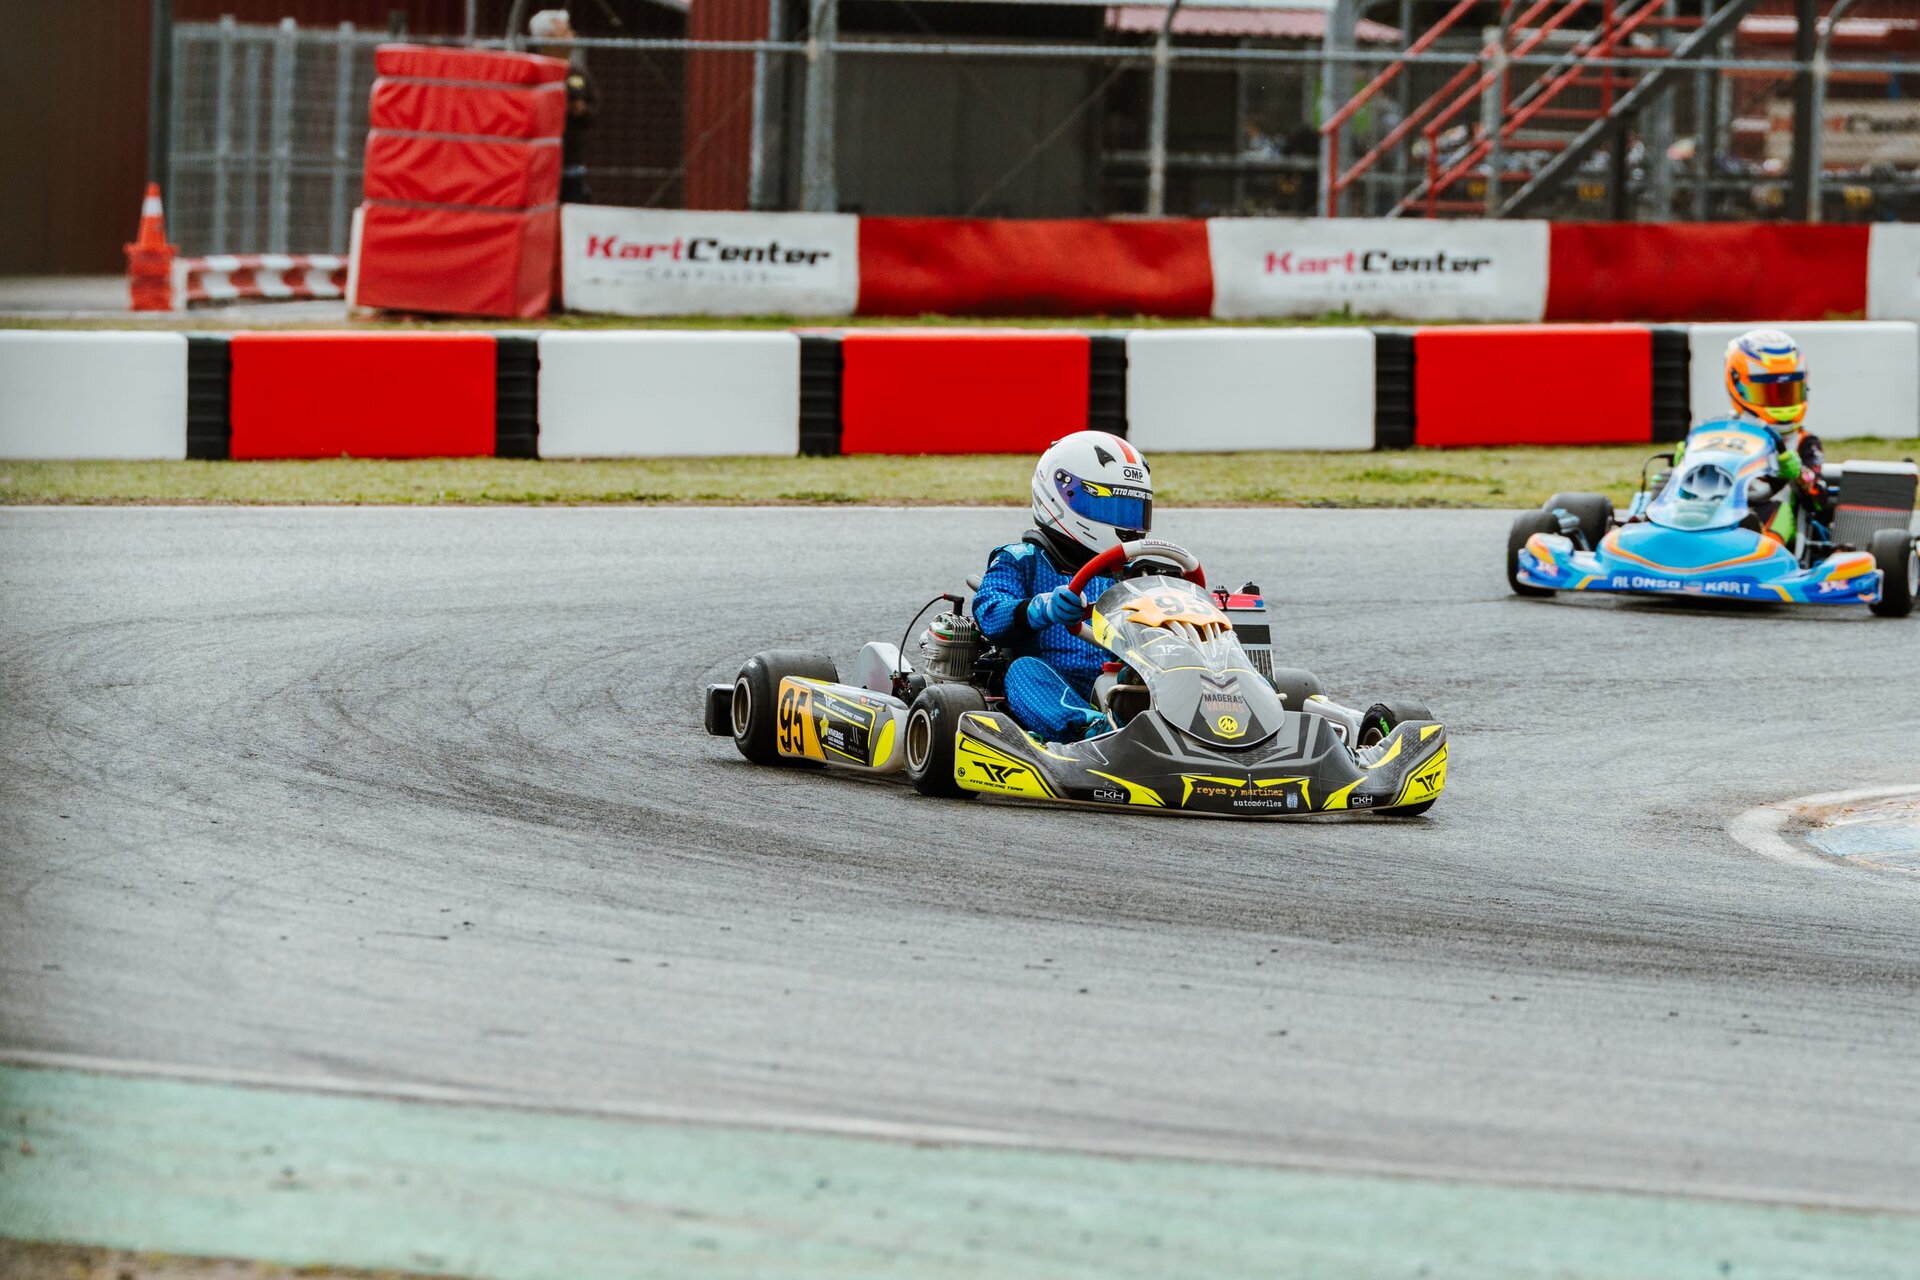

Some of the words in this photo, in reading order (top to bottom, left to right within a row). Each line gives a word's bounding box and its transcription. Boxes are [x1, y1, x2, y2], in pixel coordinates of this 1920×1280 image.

[586, 234, 830, 265] KartCenter
[1264, 250, 1491, 275] KartCenter
[1123, 468, 1144, 480] OMP
[1204, 694, 1244, 704] MADERAS
[780, 688, 808, 755] 95
[1093, 789, 1124, 800] CKH
[1196, 787, 1227, 796] reyes
[1230, 788, 1237, 797] y
[1233, 799, 1282, 807] automóviles
[1351, 795, 1373, 805] CKH
